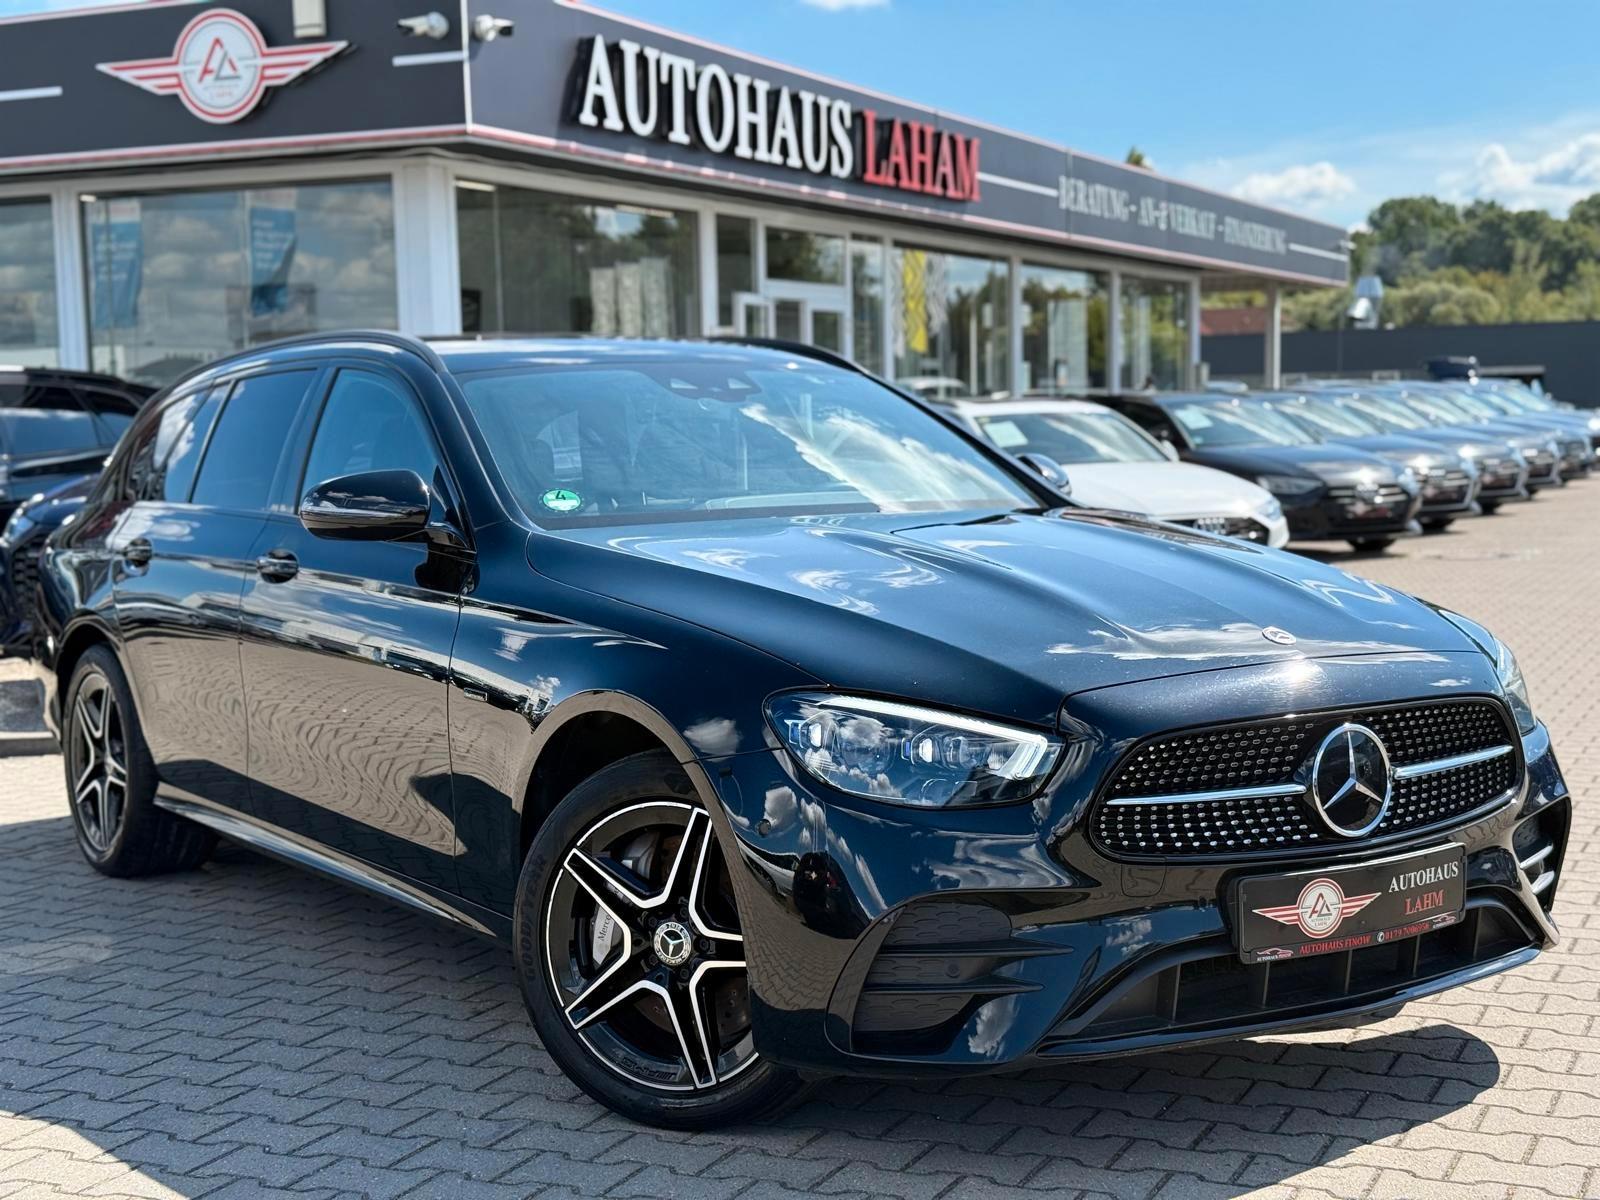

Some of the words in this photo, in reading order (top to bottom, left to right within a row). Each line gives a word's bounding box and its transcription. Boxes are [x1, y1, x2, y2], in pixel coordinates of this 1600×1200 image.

[579, 34, 853, 178] AUTOHAUS
[863, 109, 981, 201] LAHAM
[1388, 861, 1459, 893] AUTOHAUS
[1405, 889, 1444, 916] LAHM
[1300, 940, 1344, 955] AUTOHAUS
